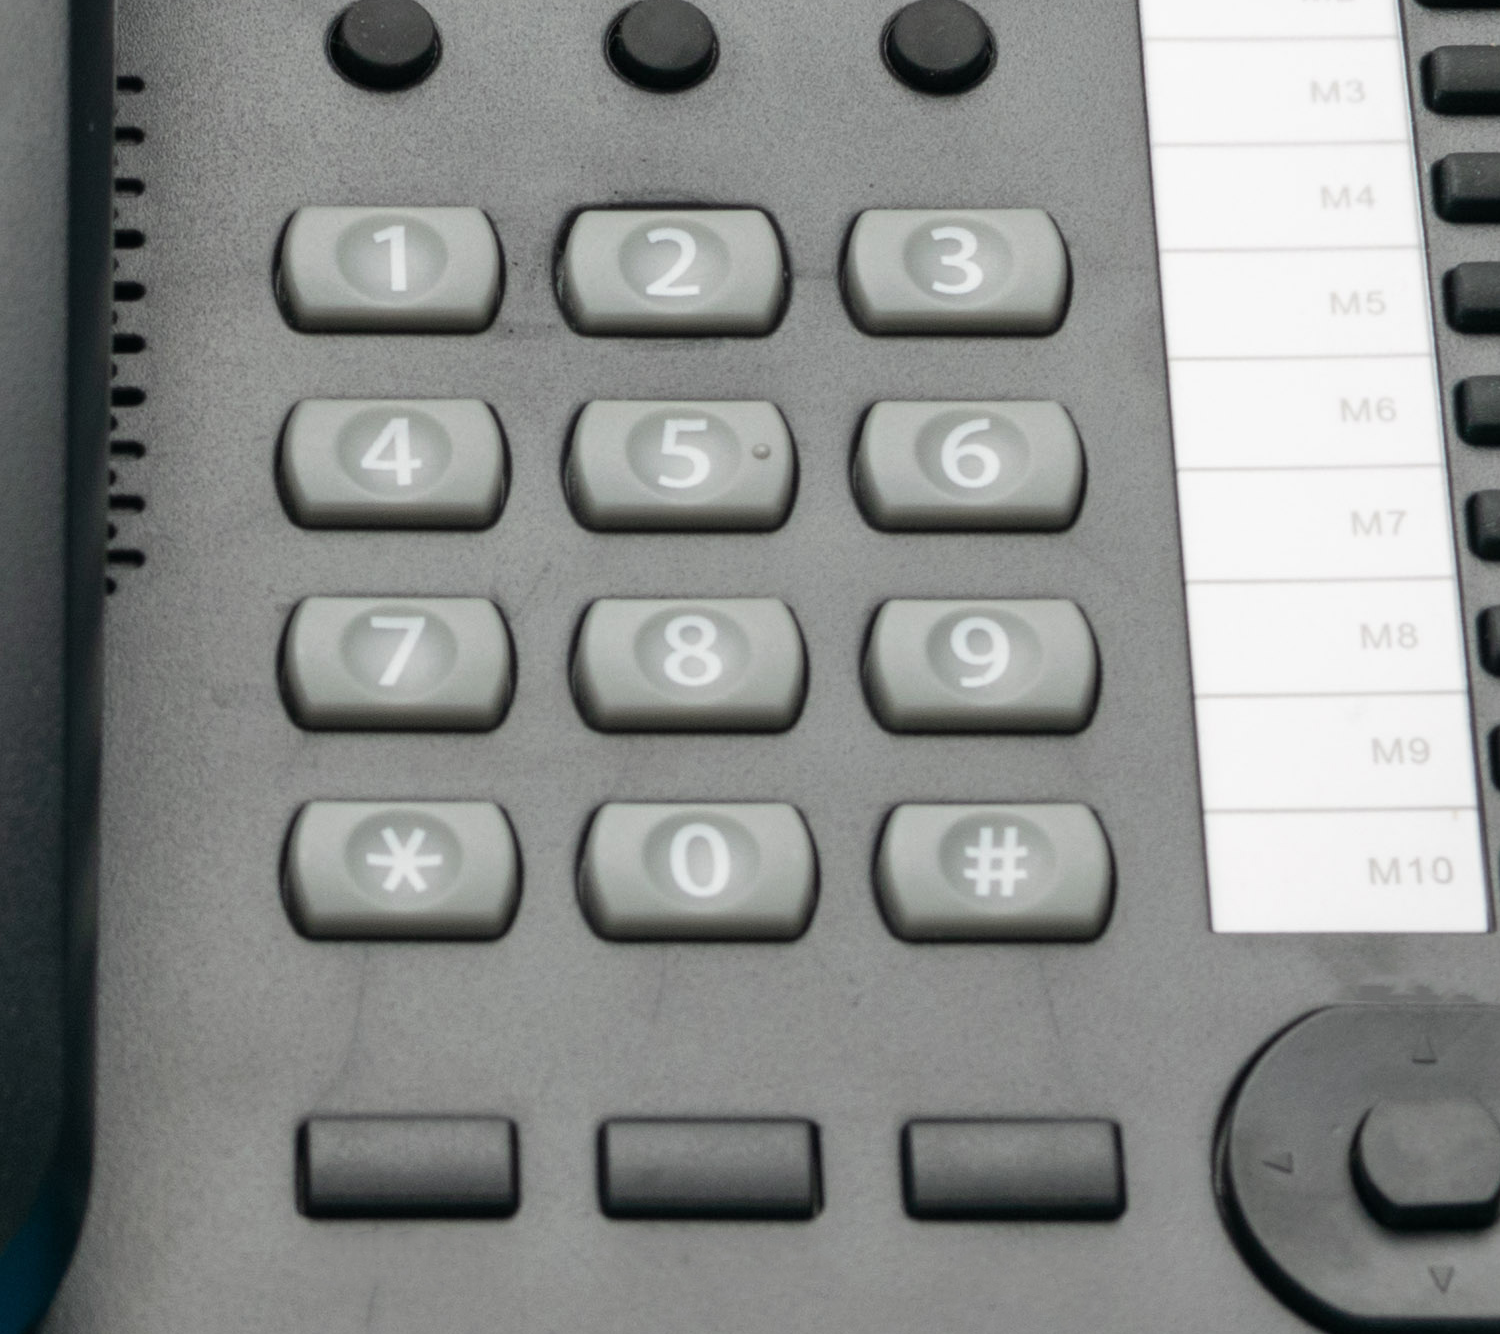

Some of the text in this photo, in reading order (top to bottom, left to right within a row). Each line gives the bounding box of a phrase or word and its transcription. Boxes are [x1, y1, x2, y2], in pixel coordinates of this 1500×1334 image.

[1310, 79, 1366, 104] M3
[1319, 184, 1376, 210] M4
[374, 226, 408, 292] 1
[646, 228, 701, 297] 2
[931, 226, 985, 295] 3
[1329, 290, 1387, 316] M5
[1339, 396, 1397, 423] M6
[361, 418, 423, 486] 4
[658, 419, 712, 489] 5
[941, 418, 1002, 488] 6
[1350, 509, 1407, 536] M7
[372, 617, 425, 686] 7
[663, 616, 724, 687] 8
[951, 618, 1011, 688] 9
[1359, 622, 1419, 650] M8
[1371, 736, 1431, 765] M9
[670, 825, 732, 897] 0
[964, 828, 1028, 897] #
[1367, 855, 1455, 885] M10
